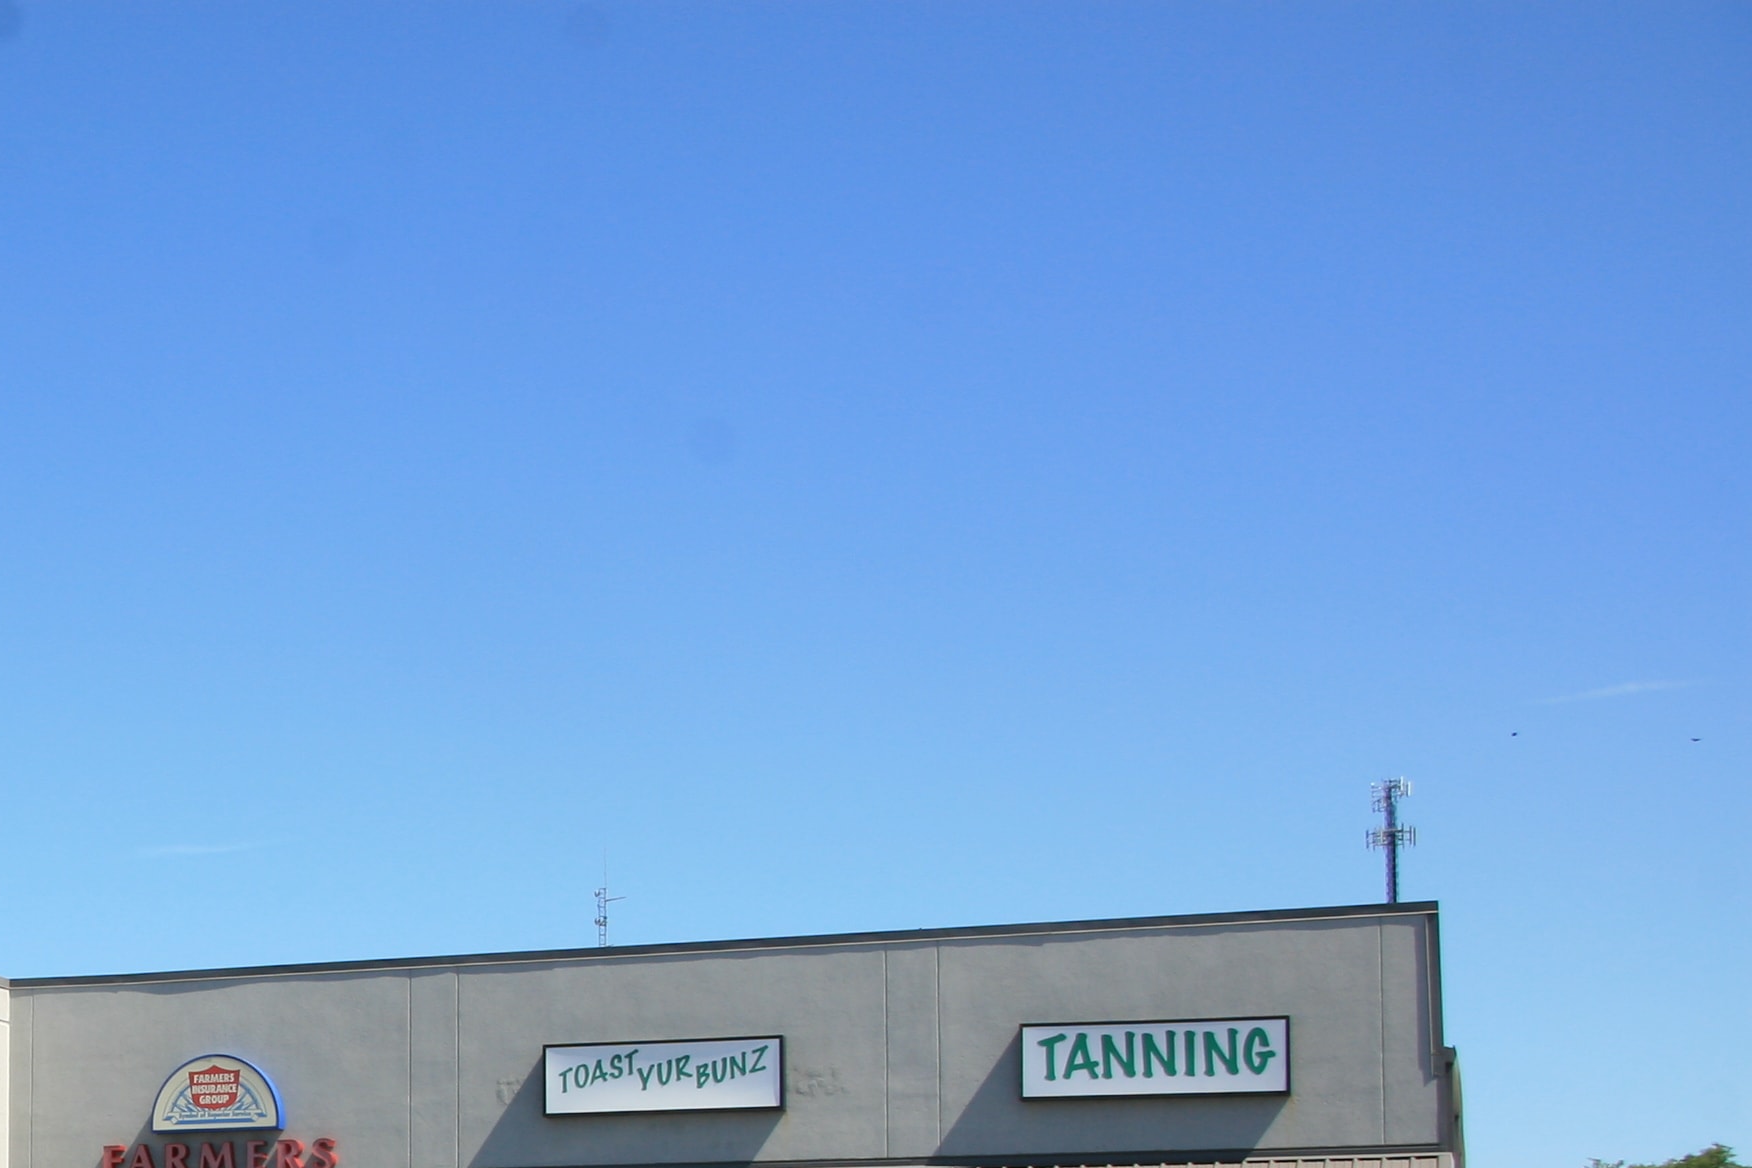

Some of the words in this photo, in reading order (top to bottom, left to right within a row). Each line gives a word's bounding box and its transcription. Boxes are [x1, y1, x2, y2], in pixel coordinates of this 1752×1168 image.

[1036, 1027, 1276, 1081] TANNING
[558, 1049, 639, 1093] TOAST
[637, 1055, 693, 1091] YUR
[695, 1045, 769, 1089] BUNZ
[194, 1073, 234, 1084] FARMERS
[191, 1084, 237, 1095] INSURANCE
[199, 1095, 230, 1105] GROUP
